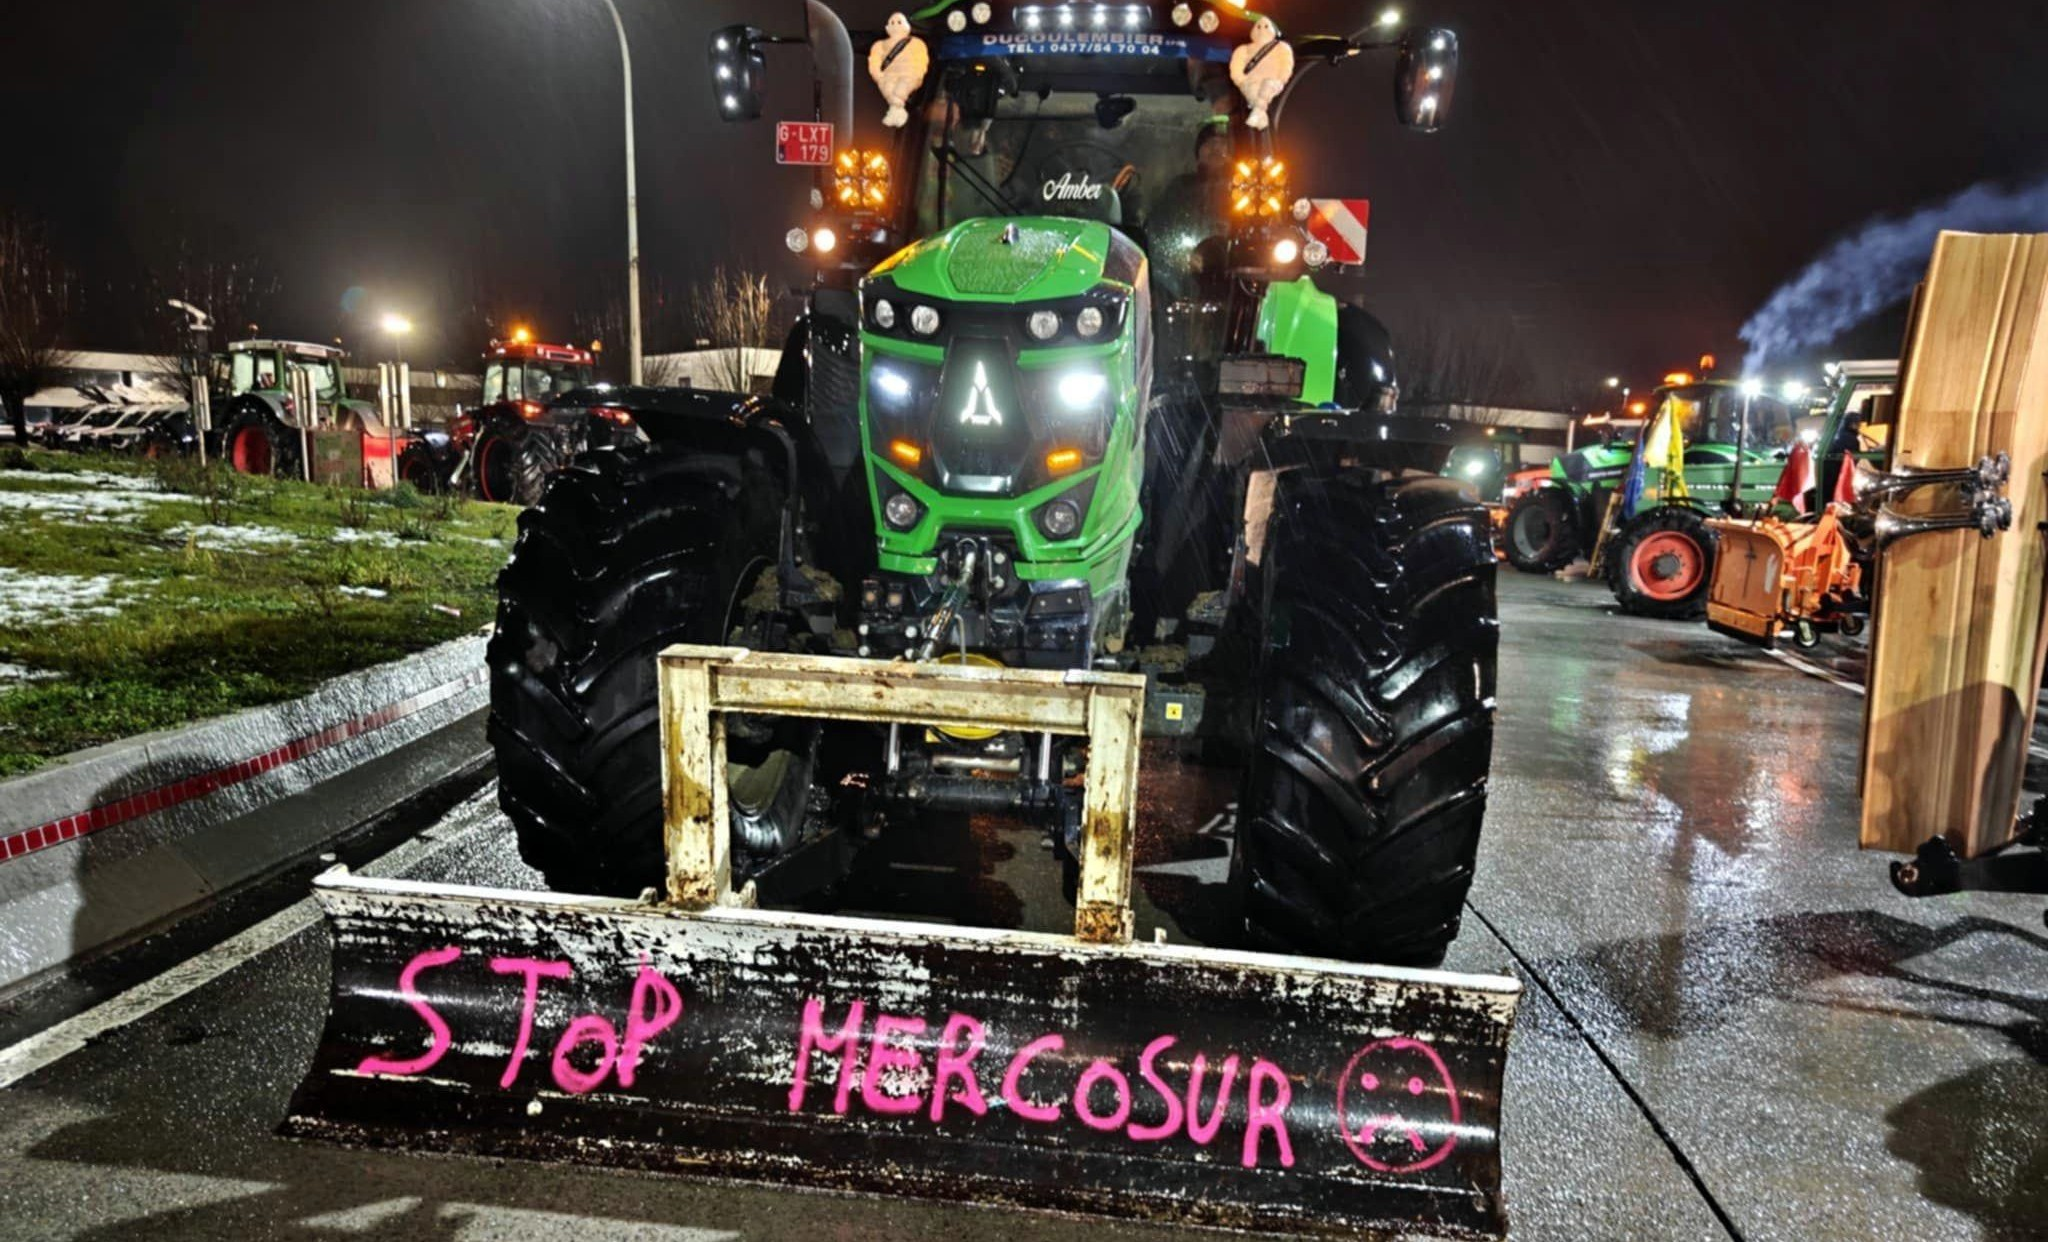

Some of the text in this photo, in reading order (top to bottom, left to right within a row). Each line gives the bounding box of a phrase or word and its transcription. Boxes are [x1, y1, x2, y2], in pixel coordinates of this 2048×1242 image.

[1119, 45, 1136, 54] 70
[1141, 45, 1160, 55] 04
[780, 125, 829, 143] G-LXT
[801, 144, 829, 162] 179
[1043, 172, 1102, 202] Amber
[788, 998, 1294, 1168] MERCOSUR
